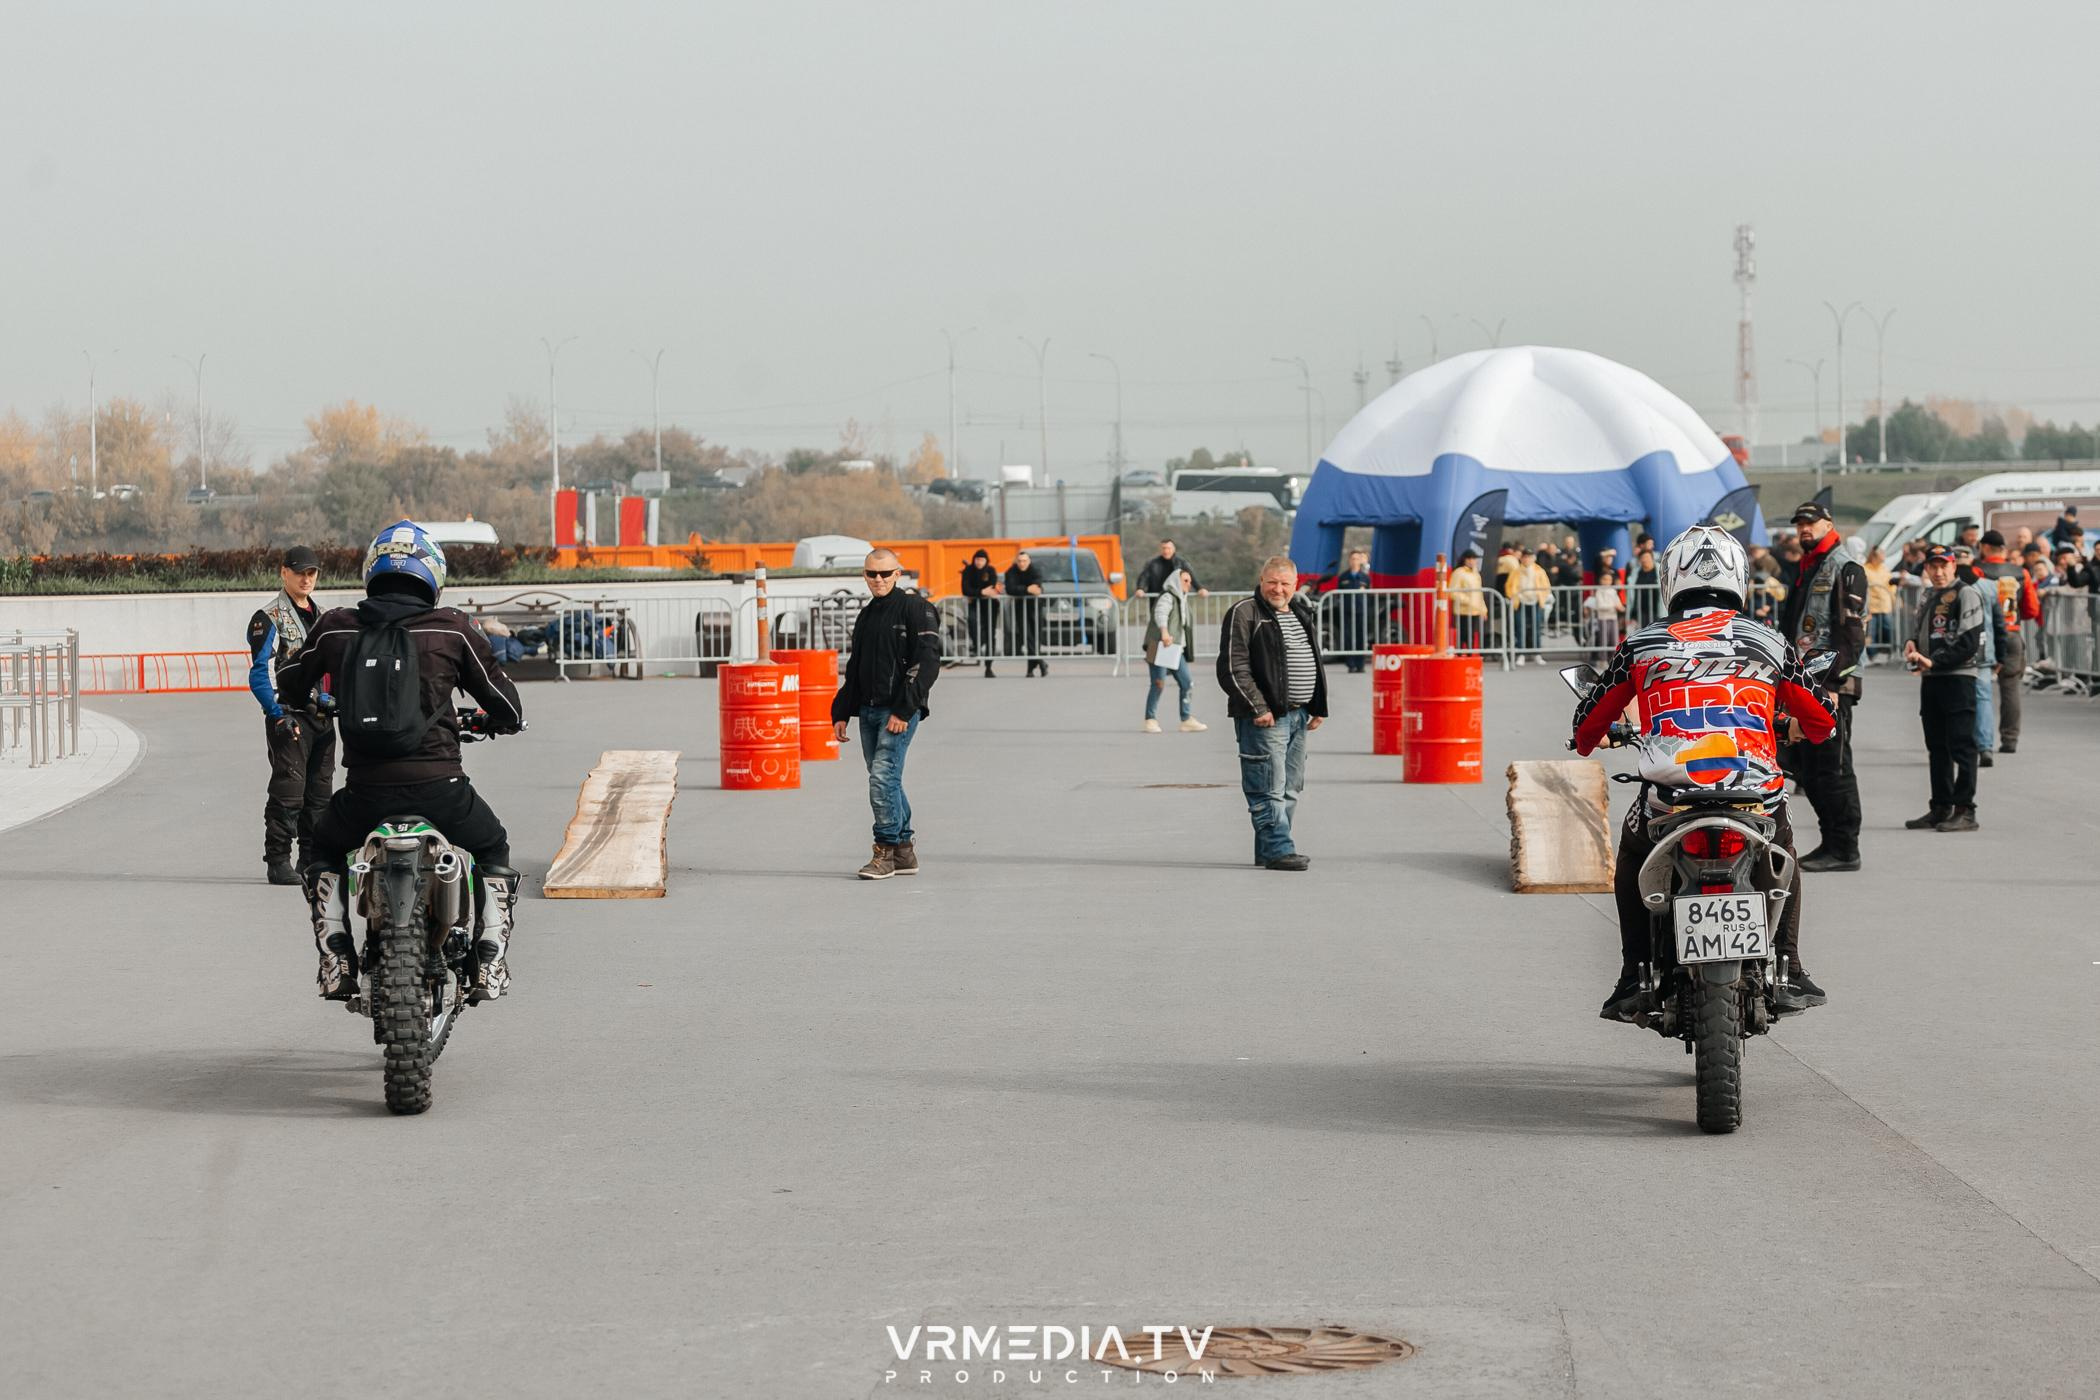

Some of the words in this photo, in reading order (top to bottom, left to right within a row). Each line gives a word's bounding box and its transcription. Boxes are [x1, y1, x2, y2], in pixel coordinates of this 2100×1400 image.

[1667, 640, 1746, 651] HONDA
[1648, 684, 1776, 735] HRC
[483, 878, 510, 923] FOX
[1688, 900, 1751, 924] 8465
[1723, 924, 1746, 932] RUS
[1683, 934, 1722, 958] AM
[1731, 932, 1761, 954] 42
